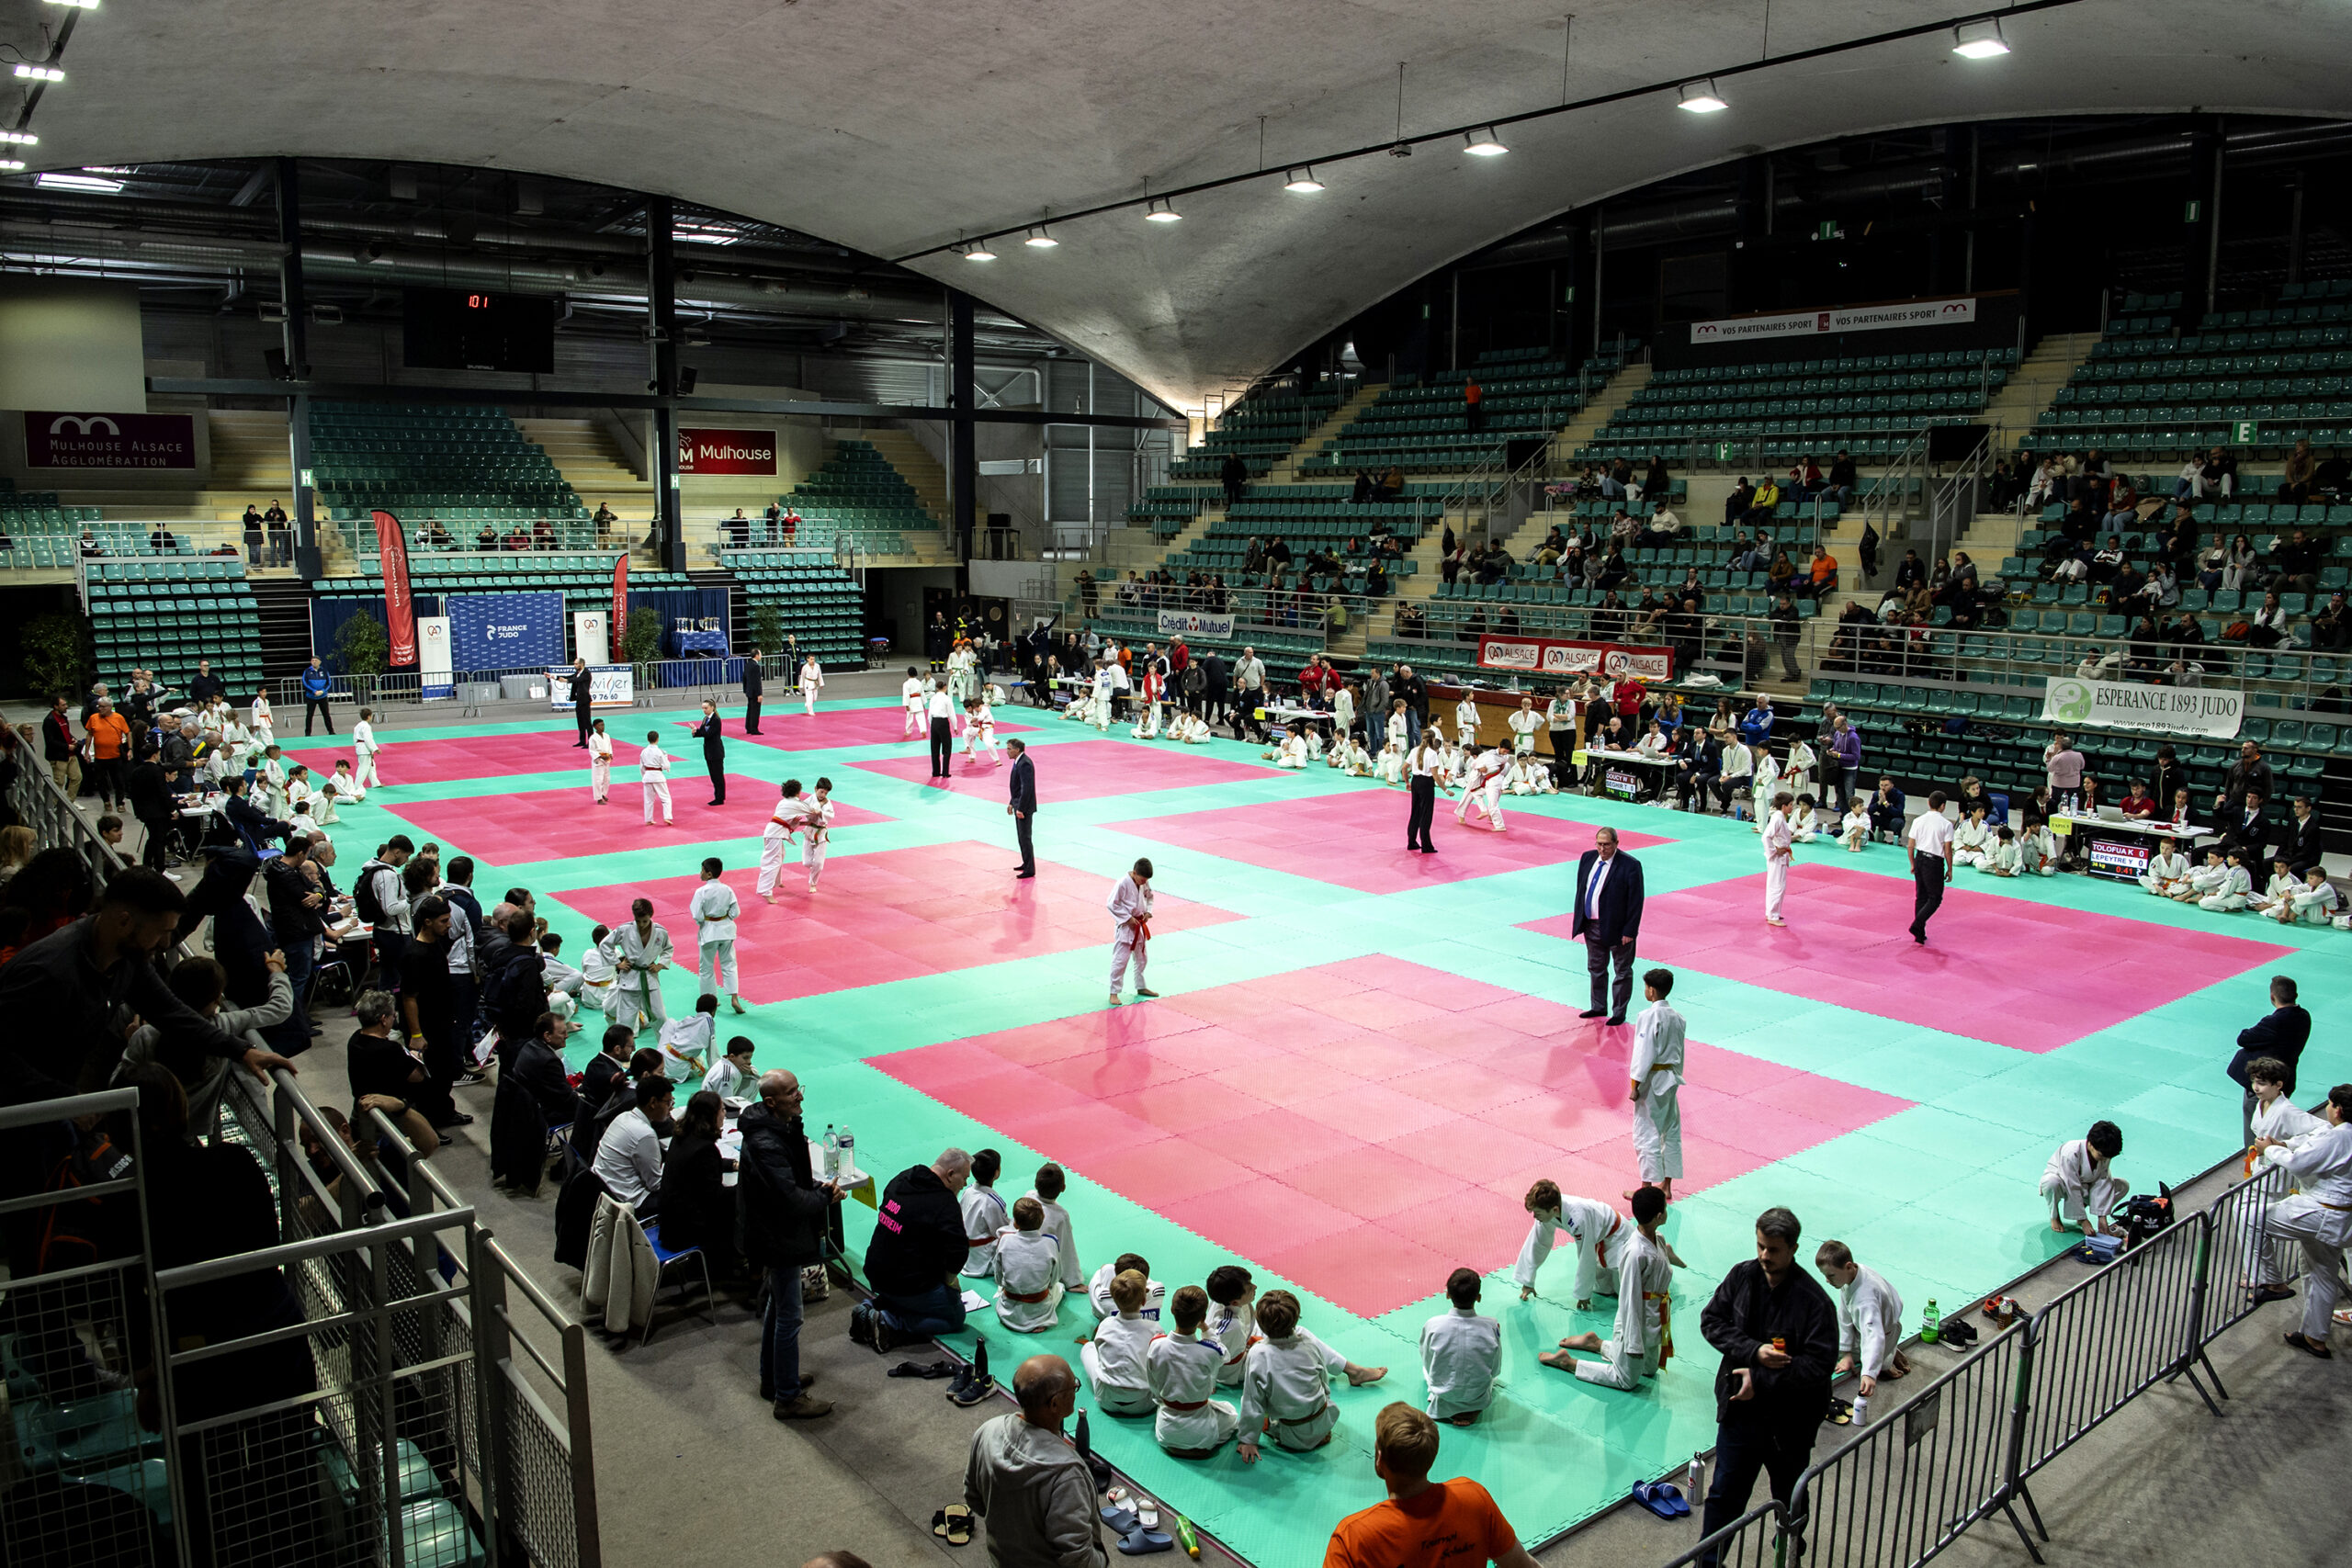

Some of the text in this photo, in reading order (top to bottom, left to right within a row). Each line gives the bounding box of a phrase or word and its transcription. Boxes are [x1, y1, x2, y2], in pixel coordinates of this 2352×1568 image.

[1836, 318, 1849, 326] VOS
[1852, 313, 1907, 324] PARTENAIRES
[1909, 309, 1936, 320] SPORT
[1722, 327, 1736, 335] VOS
[1738, 322, 1786, 333] PARTENAIRES
[1788, 320, 1812, 330] SPORT
[2239, 423, 2250, 442] E
[680, 448, 693, 463] M
[700, 445, 771, 460] Mulhouse
[1720, 444, 1728, 459] F
[301, 471, 311, 485] H
[672, 475, 679, 488] H
[1161, 615, 1230, 632] Crédit Mutuel
[1504, 648, 1535, 660] ALSACE
[1564, 653, 1598, 665] ALSACE
[1628, 660, 1664, 671] ALSACE
[484, 688, 489, 697] 2
[2096, 688, 2166, 711] ESPERANCE
[2170, 694, 2197, 714] 1893
[2199, 696, 2237, 719] JUDO
[1606, 773, 1622, 781] DOUCY
[2092, 844, 2127, 855] TOLOFUA
[2091, 854, 2127, 864] LEPEYTRE
[885, 1199, 901, 1214] JUDO
